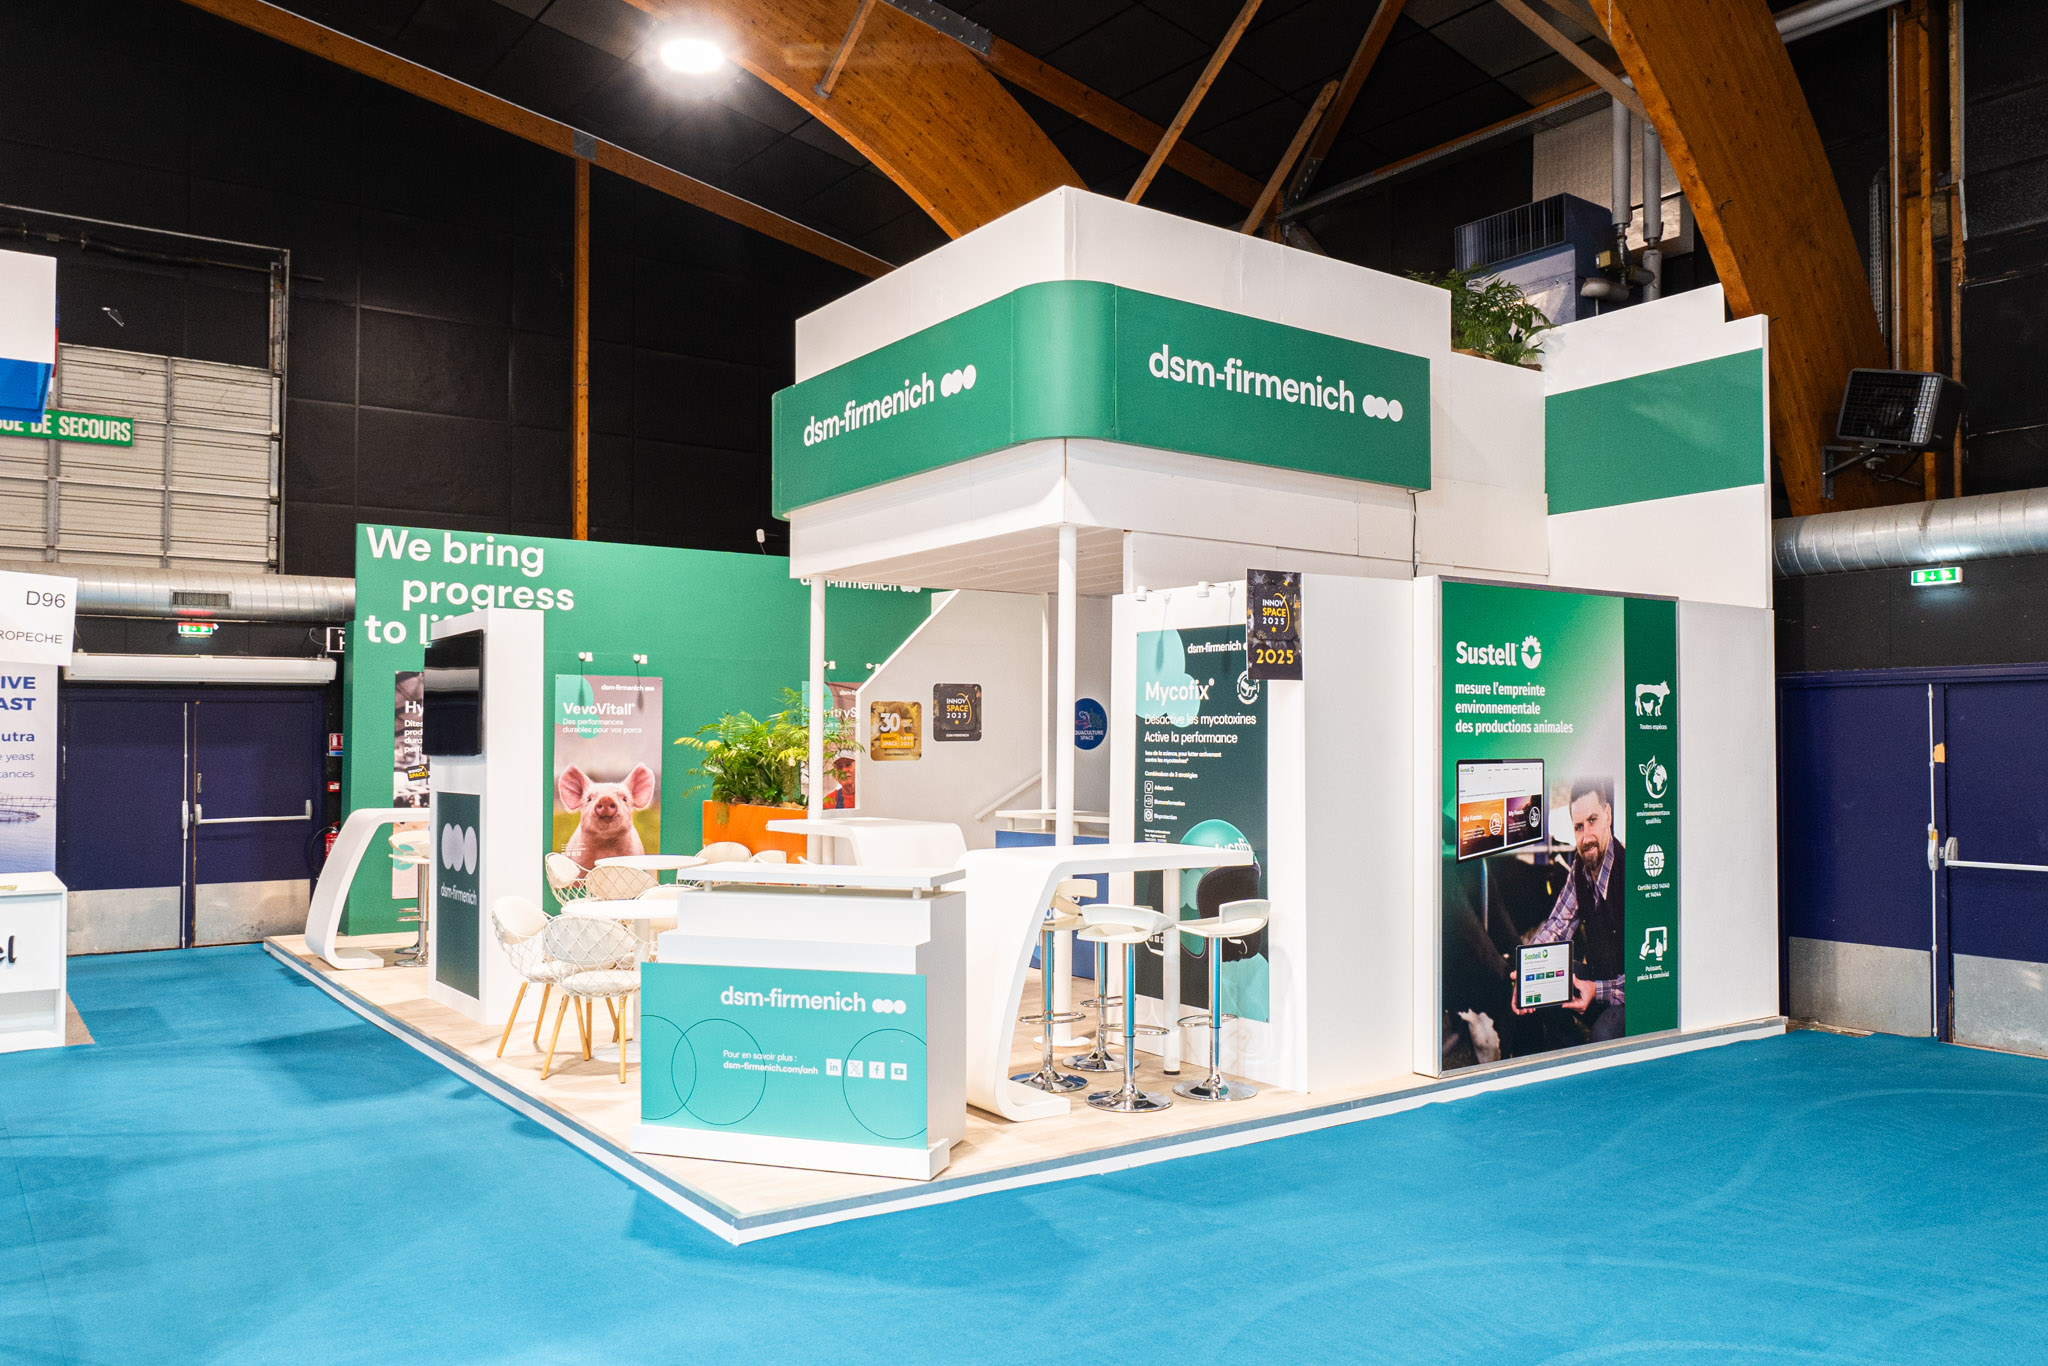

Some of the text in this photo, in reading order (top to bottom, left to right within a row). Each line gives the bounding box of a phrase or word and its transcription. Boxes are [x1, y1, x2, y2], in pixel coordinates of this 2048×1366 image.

[1149, 343, 1354, 414] dsm-firmenich
[803, 371, 935, 447] dsm-firmenich
[58, 415, 131, 442] SECOURS
[366, 527, 544, 578] We bring
[26, 590, 66, 608] D96
[402, 579, 575, 612] progress
[1262, 598, 1284, 607] INNOV
[1262, 607, 1287, 617] SPACE
[364, 614, 407, 644] to
[1262, 617, 1285, 626] 2025
[1187, 641, 1242, 654] dsm-firmenich
[1456, 640, 1517, 667] Sustell
[1256, 648, 1294, 665] 2025
[1, 676, 36, 690] IVE
[601, 684, 644, 692] dsm-firmenich
[1455, 683, 1492, 695] mesure
[946, 704, 969, 712] SPACE
[1455, 699, 1541, 715] environnementale
[577, 718, 624, 727] performances
[880, 712, 901, 732] 30
[1144, 712, 1257, 728] Désactive les mycotoxines
[1455, 719, 1574, 736] des productions animales
[1, 732, 35, 742] utra
[593, 726, 609, 735] pour
[624, 726, 642, 734] porcs
[1144, 730, 1238, 746] Active la performance
[5, 753, 35, 762] yeast
[1647, 857, 1660, 867] ISO
[441, 882, 477, 906] dsm-firmenich
[720, 986, 866, 1012] dsm-firmenich
[723, 1049, 740, 1059] Pour
[741, 1052, 752, 1060] en
[753, 1052, 776, 1061] savoir
[777, 1053, 793, 1063] plus
[723, 1060, 819, 1075] dsm-firmenich.com/anh
